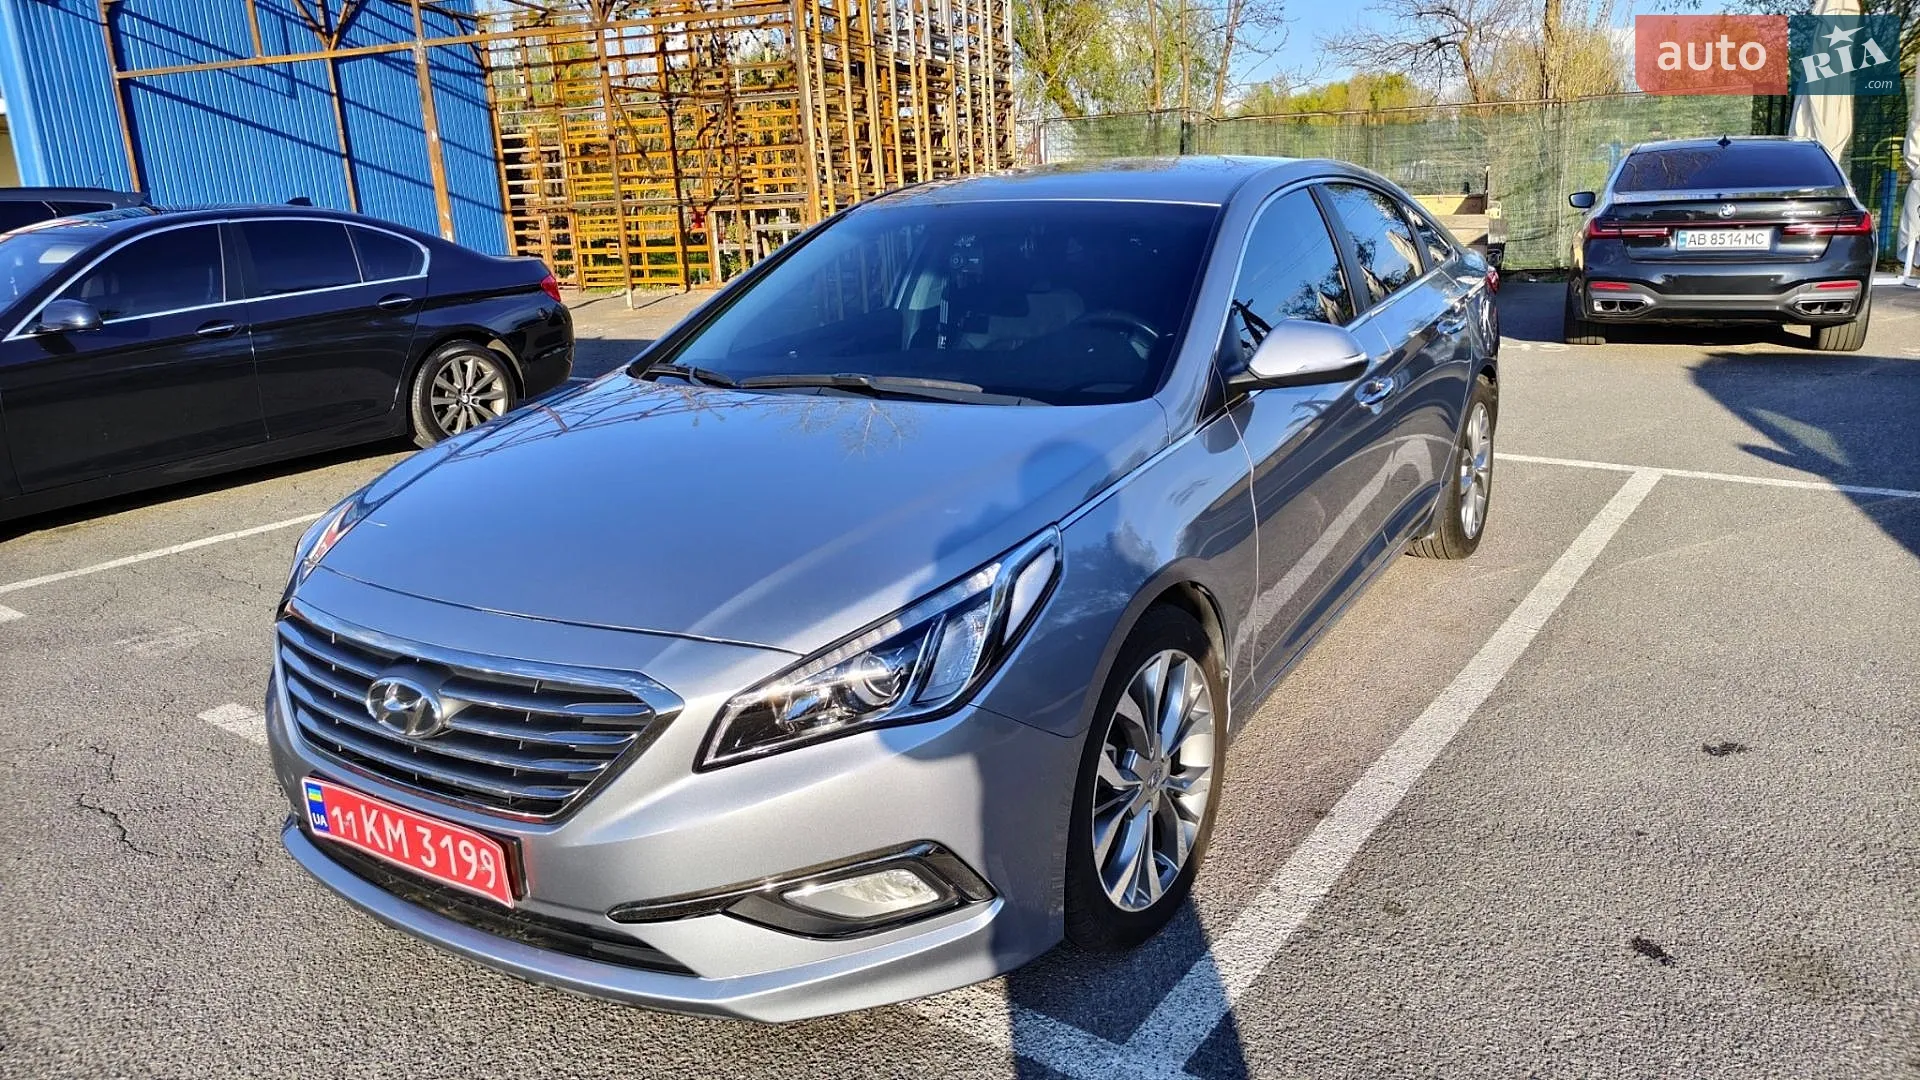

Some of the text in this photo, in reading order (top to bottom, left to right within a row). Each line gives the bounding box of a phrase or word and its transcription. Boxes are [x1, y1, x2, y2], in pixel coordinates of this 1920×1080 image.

[1688, 232, 1765, 246] AB 8514 MC
[312, 812, 328, 828] UA
[416, 825, 496, 889] 3199
